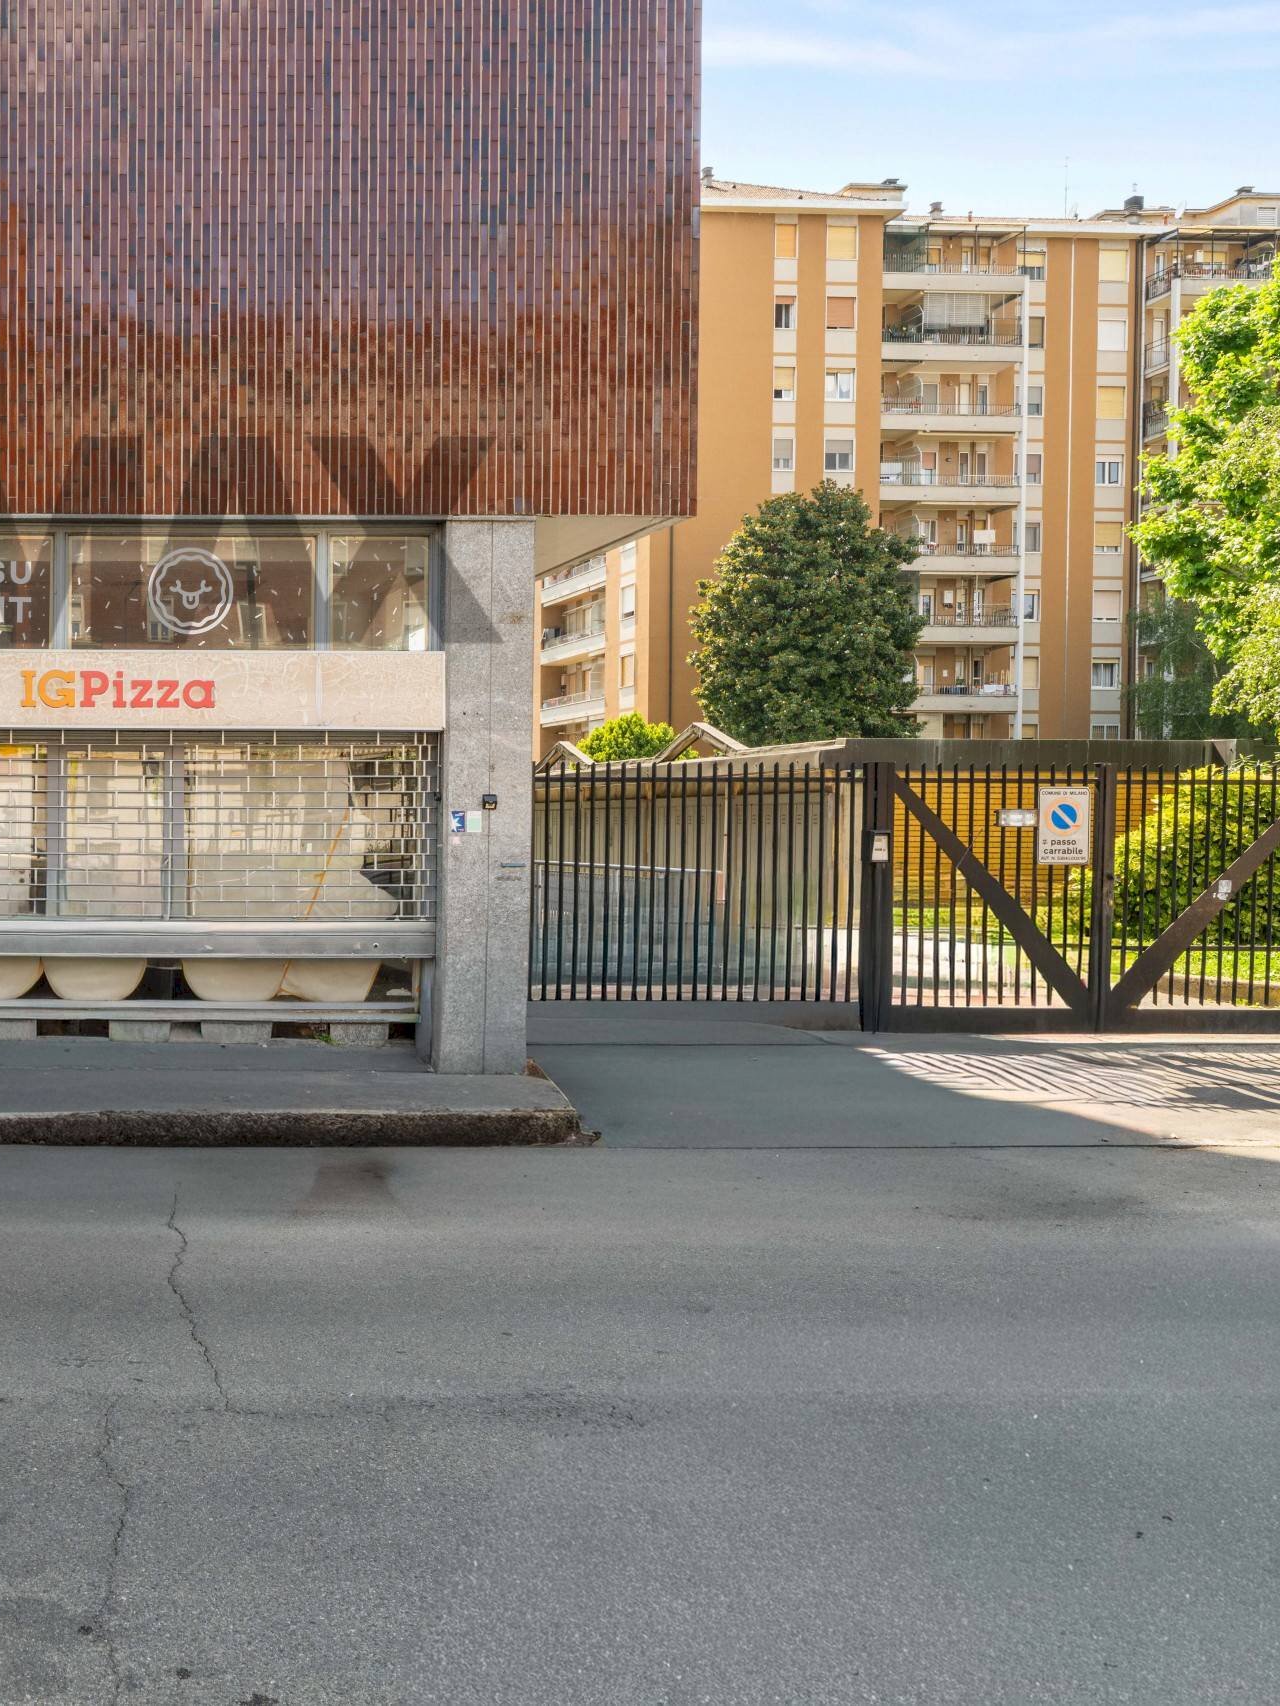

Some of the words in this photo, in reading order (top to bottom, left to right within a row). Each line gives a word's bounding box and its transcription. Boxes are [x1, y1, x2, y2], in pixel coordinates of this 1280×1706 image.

[21, 669, 216, 709] IGPizza
[1050, 839, 1077, 847] passo
[1043, 847, 1083, 855] carrabile
